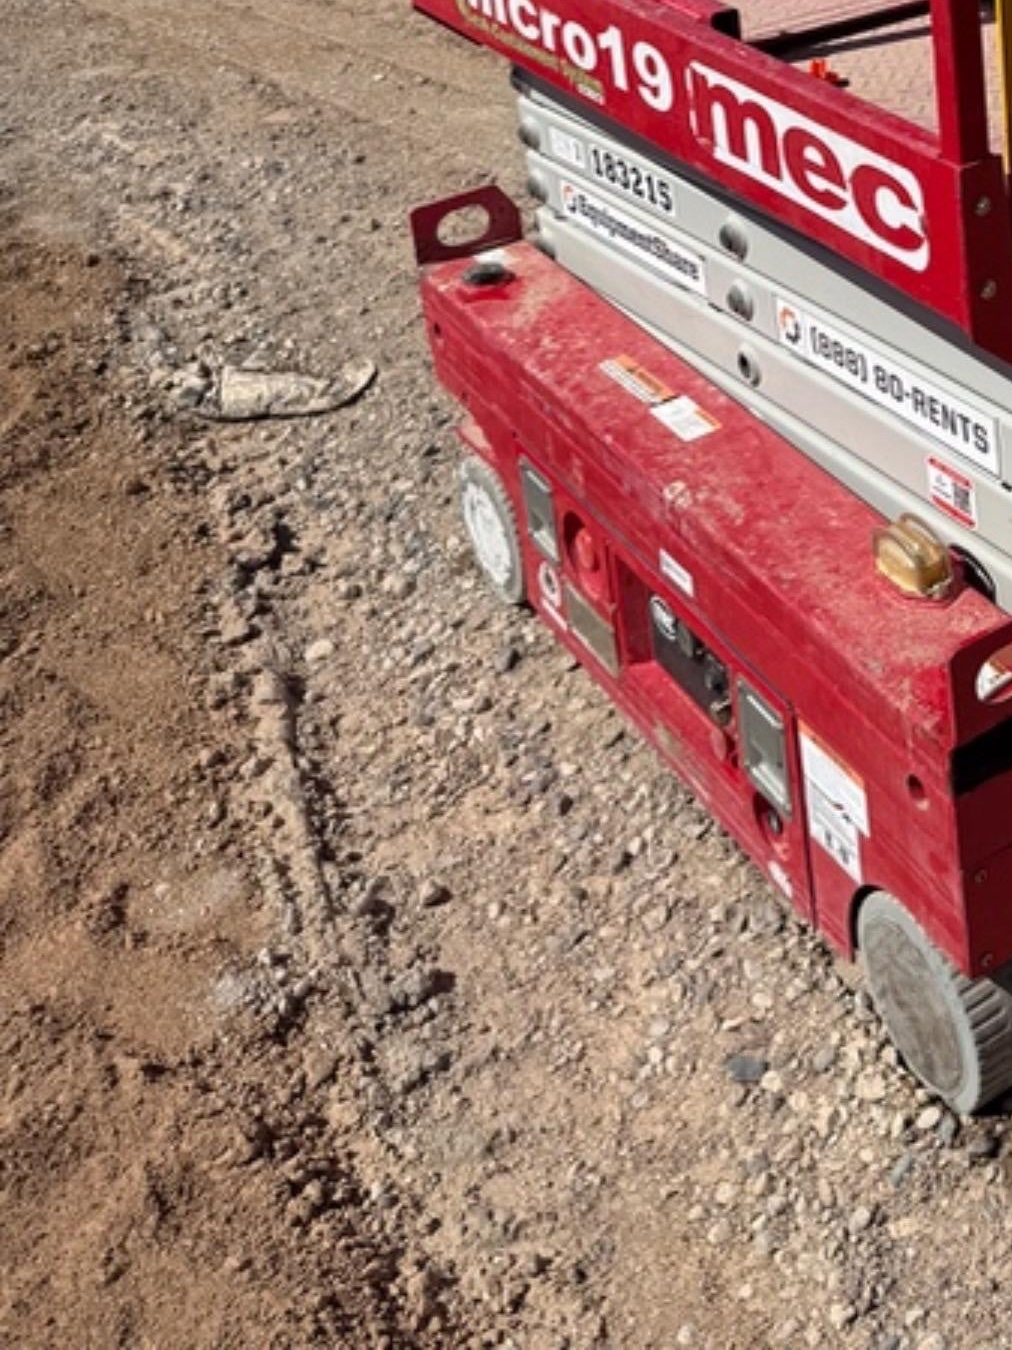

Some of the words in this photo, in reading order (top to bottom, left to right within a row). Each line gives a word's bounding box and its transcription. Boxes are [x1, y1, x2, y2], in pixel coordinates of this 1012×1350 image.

[592, 148, 673, 212] 183215
[689, 65, 928, 258] mec
[578, 194, 700, 281] EquipmentShare
[810, 326, 868, 382] (888)
[873, 365, 990, 453] 80-RENTS
